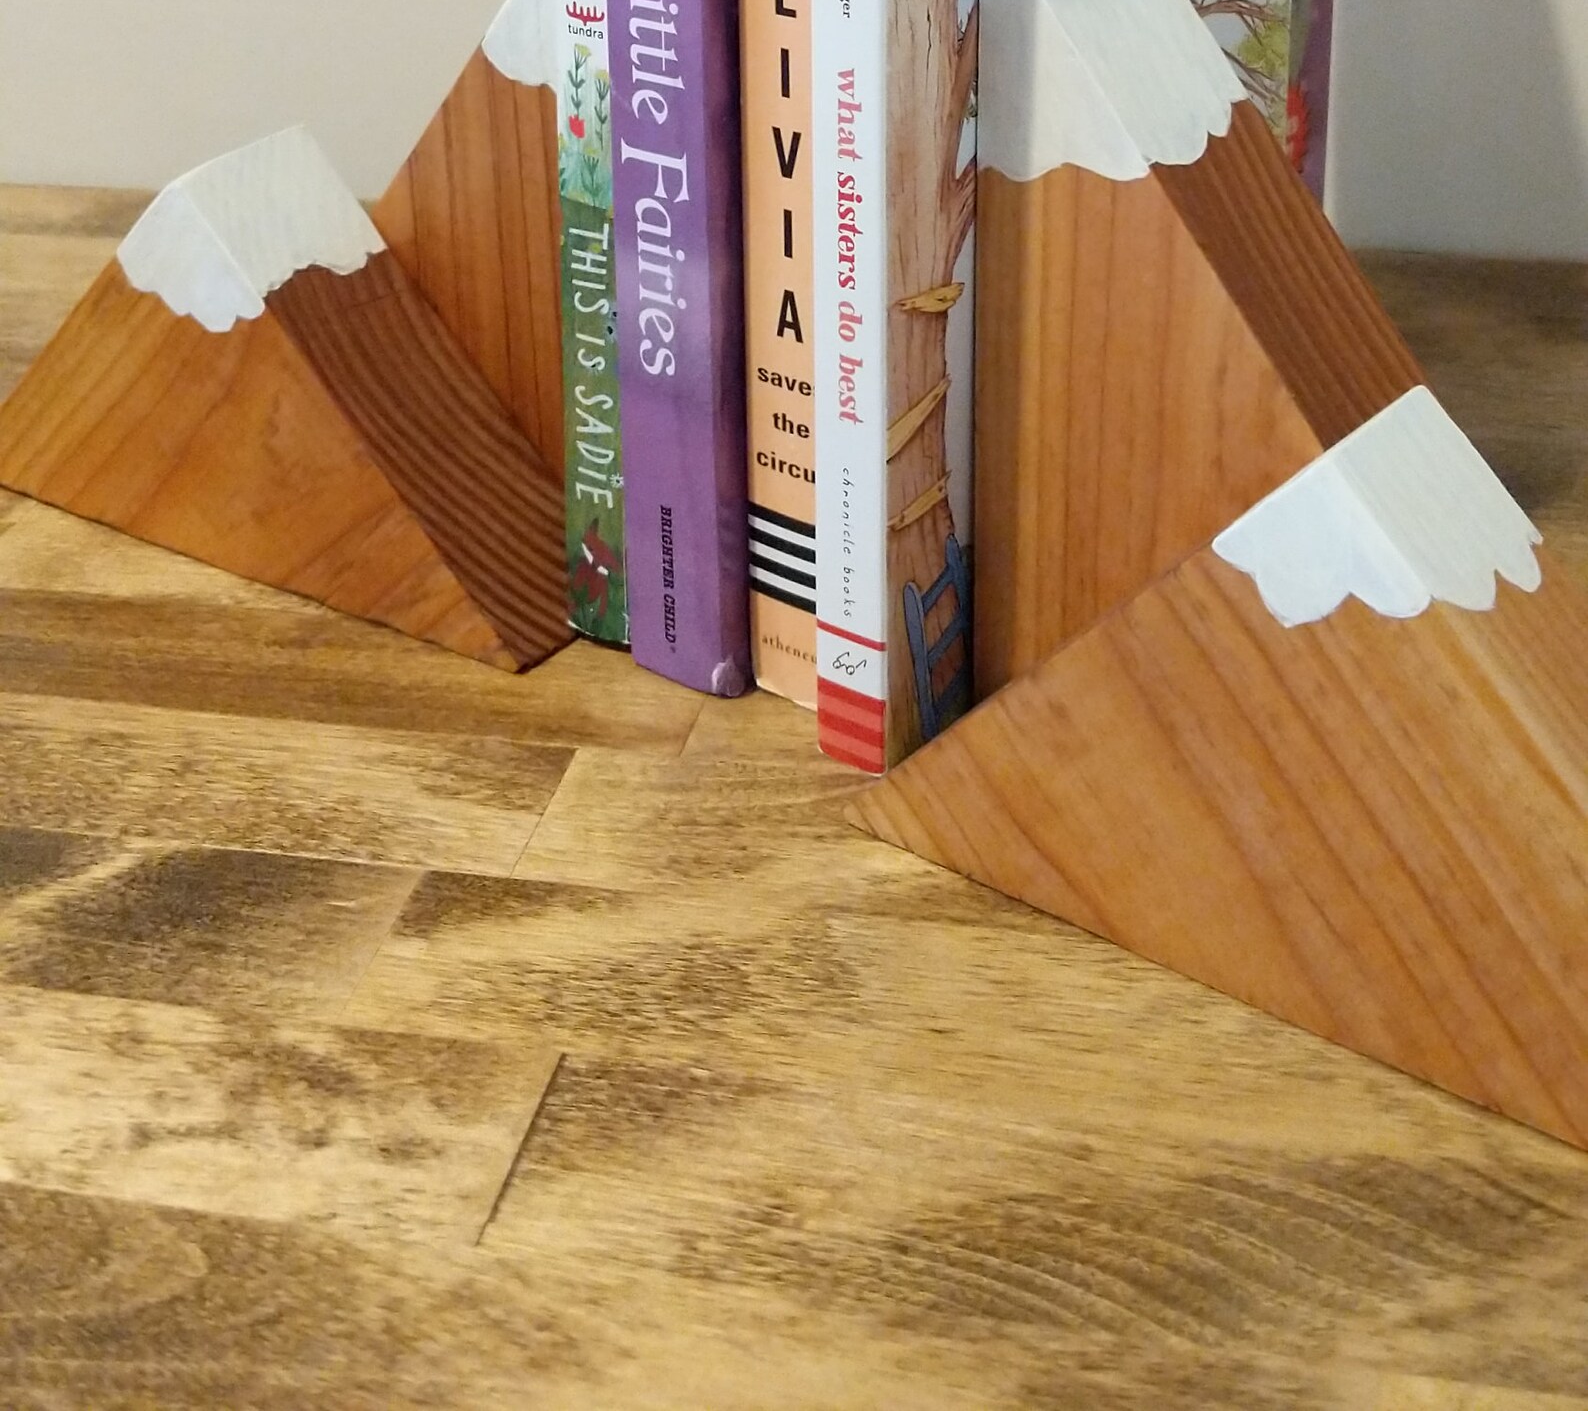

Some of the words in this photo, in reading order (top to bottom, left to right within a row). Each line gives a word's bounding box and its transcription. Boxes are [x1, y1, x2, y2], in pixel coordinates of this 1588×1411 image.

[567, 23, 605, 40] tundra
[837, 68, 864, 163] what
[568, 222, 610, 317] THIS
[620, 136, 690, 378] Fairies
[837, 170, 864, 291] sisters
[575, 332, 606, 372] IS
[838, 300, 864, 343] do
[757, 366, 816, 397] save
[838, 353, 865, 426] best
[575, 384, 615, 510] SADIE
[772, 411, 811, 440] the
[660, 504, 675, 590] BRIGHTER
[842, 467, 855, 555] chronicle
[842, 566, 855, 618] books
